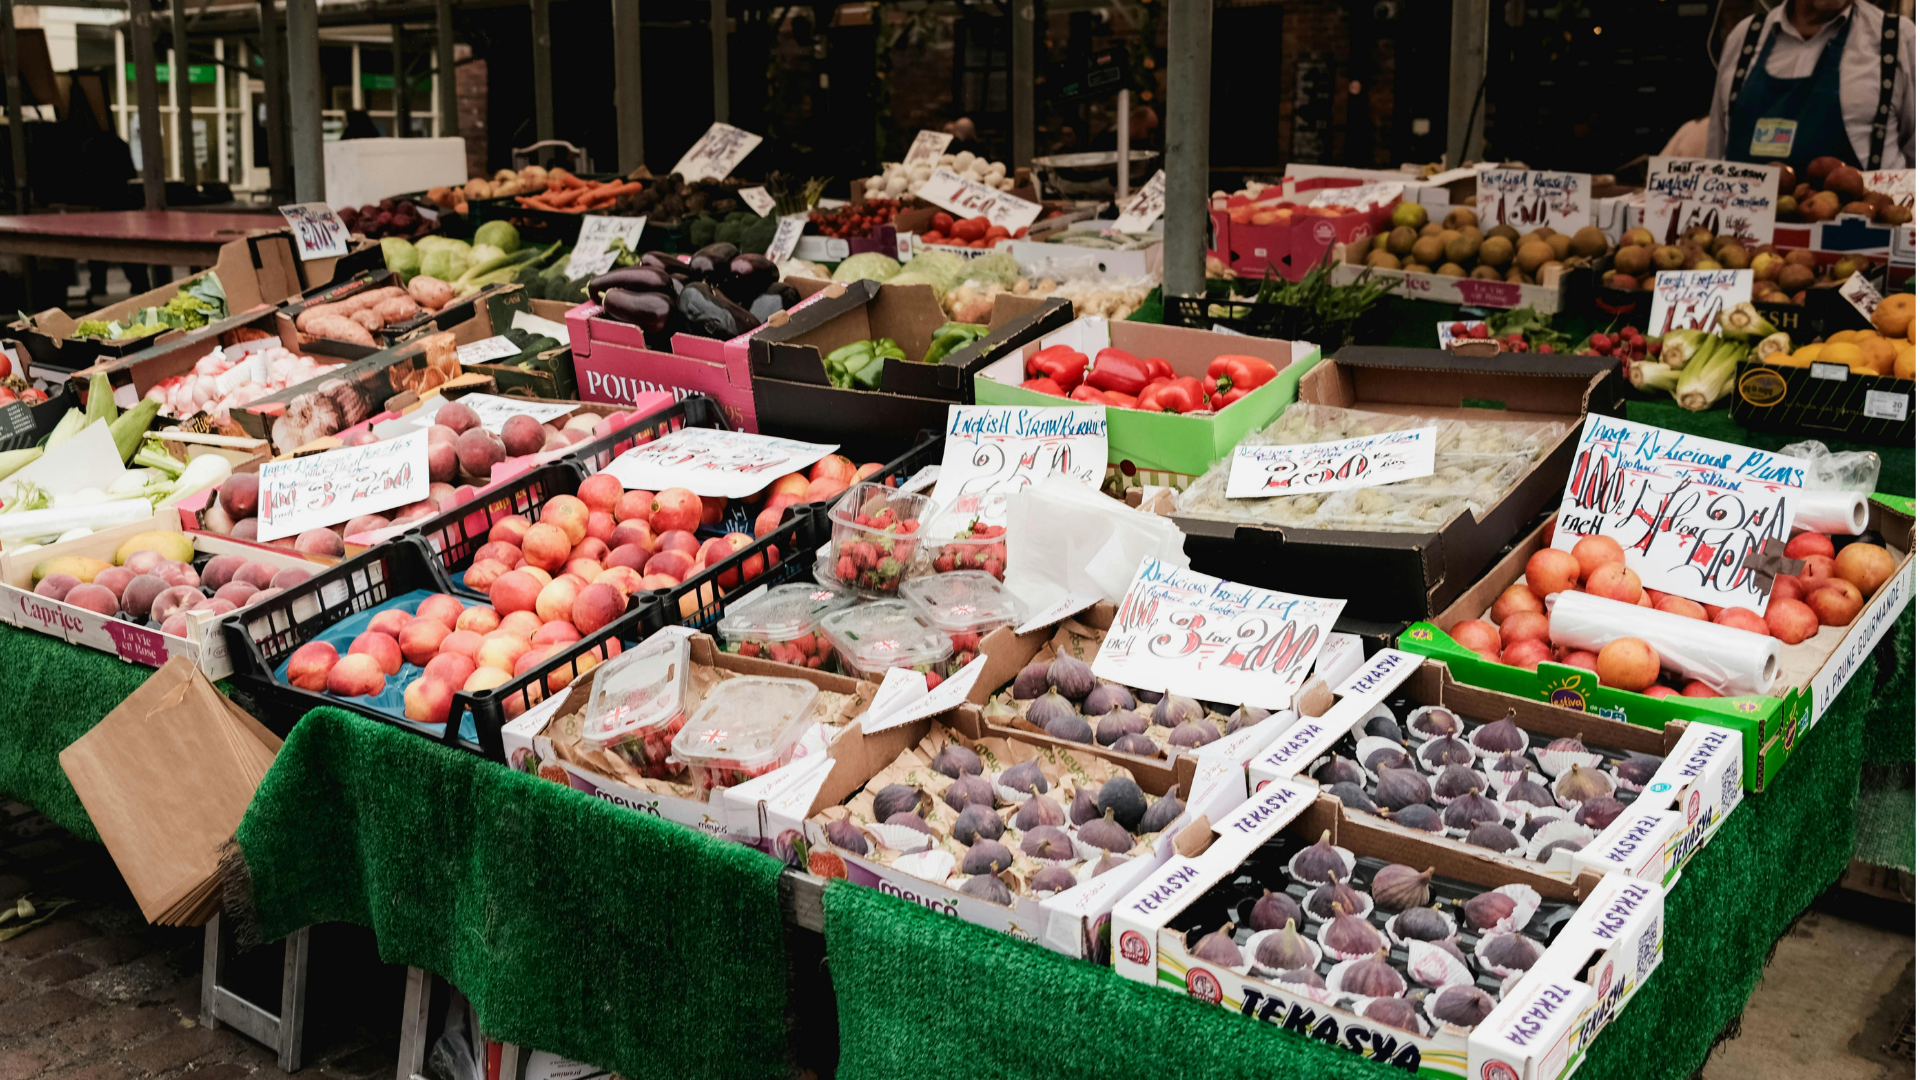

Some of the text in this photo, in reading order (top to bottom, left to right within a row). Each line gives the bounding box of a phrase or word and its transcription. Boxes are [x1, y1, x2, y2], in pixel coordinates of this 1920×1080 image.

[1758, 310, 1799, 329] SH
[19, 595, 84, 634] Caprice
[121, 628, 152, 647] La Vie
[1147, 611, 1207, 658] 3
[121, 641, 157, 660] en Rose
[1819, 687, 1830, 713] LA
[1831, 645, 1856, 694] PRUNE
[1857, 583, 1900, 657] GOURMANDE
[1349, 654, 1403, 694] TEKASYA
[1265, 721, 1324, 767] TEKASYA
[1678, 731, 1730, 777] TEKASYA
[1233, 786, 1297, 833] TEKASYA
[1605, 815, 1663, 863] TEKASYA
[1671, 805, 1713, 871] TEKASYA
[1131, 864, 1201, 915] TEKASYA
[1593, 883, 1652, 940] TEKASYA
[1238, 984, 1423, 1075] TEKASYA
[1504, 983, 1573, 1047] TEKASYA
[1577, 972, 1627, 1050] TEKASYA
